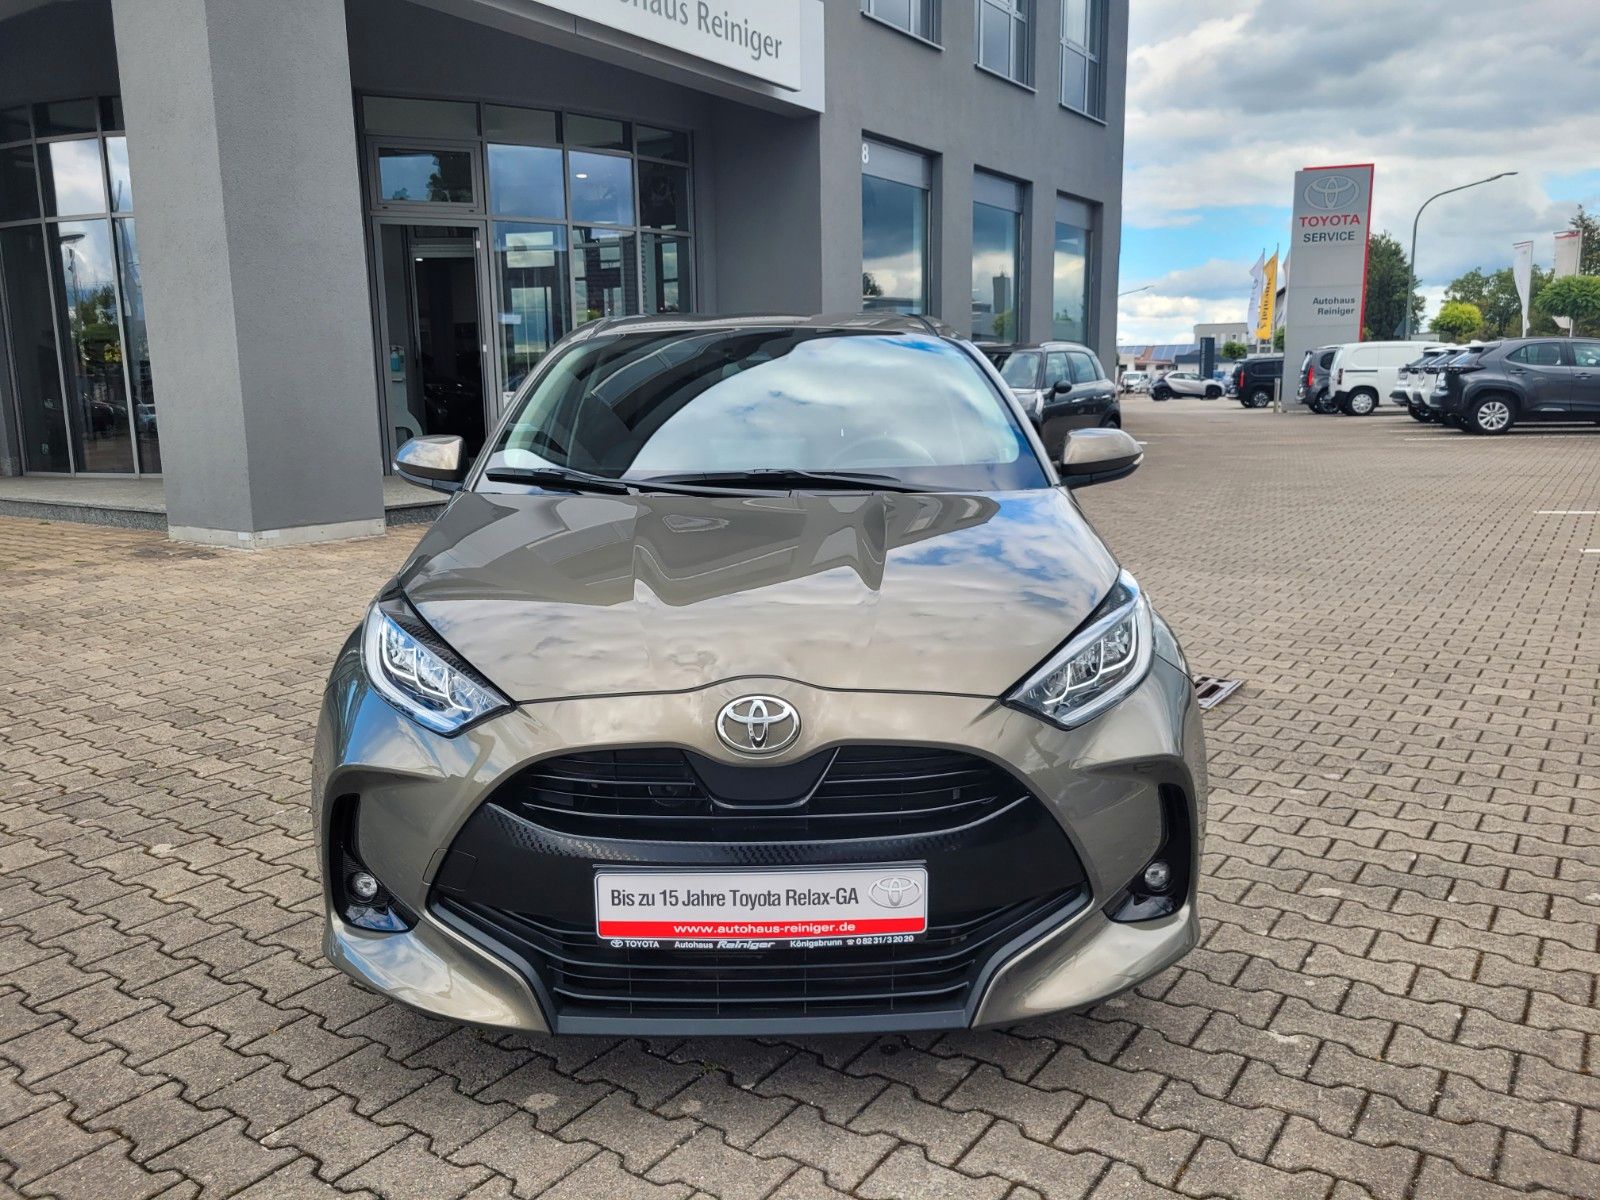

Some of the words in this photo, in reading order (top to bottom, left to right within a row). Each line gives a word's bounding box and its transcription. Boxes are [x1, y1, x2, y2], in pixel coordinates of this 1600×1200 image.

[697, 0, 782, 61] Reiniger
[861, 143, 869, 164] 8
[1299, 214, 1361, 228] TOYOTA
[1303, 231, 1355, 243] SERVICE
[1312, 297, 1355, 305] Autohaus
[1317, 307, 1355, 317] Reiniger
[610, 889, 635, 907] Bis
[638, 893, 656, 907] zu
[659, 889, 679, 907] 15
[681, 889, 726, 907] Jahre
[729, 889, 781, 911] Toyota
[785, 887, 859, 906] Relax-GA
[673, 922, 856, 935] www.autohaus-reiniger.de
[625, 940, 660, 948] TOYOTA
[674, 941, 713, 949] Autohaus
[716, 940, 776, 950] Reiniger
[790, 940, 843, 948] Königsbrunn
